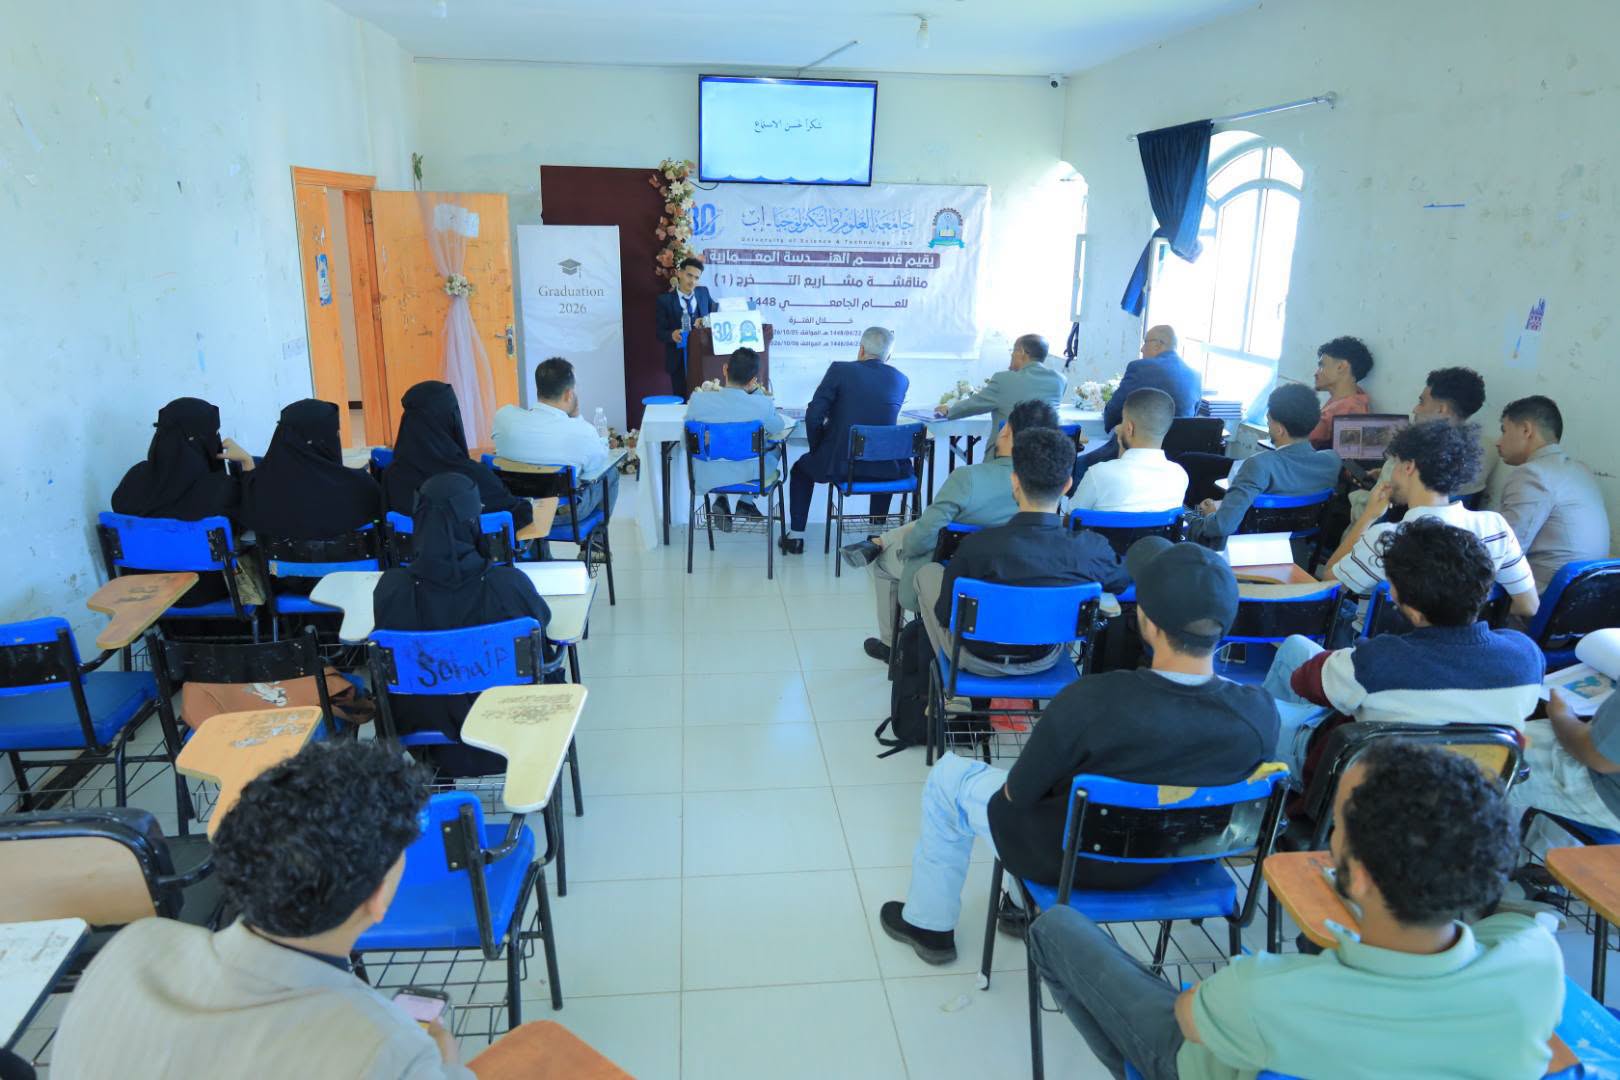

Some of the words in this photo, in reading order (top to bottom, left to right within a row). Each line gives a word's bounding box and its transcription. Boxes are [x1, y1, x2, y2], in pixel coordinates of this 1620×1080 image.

[741, 236, 784, 244] University
[708, 248, 780, 264] المعمارية
[783, 251, 850, 265] الهندسة
[905, 254, 935, 268] يقيم
[736, 273, 801, 288] التخرج
[803, 273, 864, 289] مشاريع
[865, 274, 929, 289] مناقشة
[538, 284, 605, 298] Graduation
[559, 302, 588, 315] 2026
[778, 297, 860, 312] الجامعي
[861, 297, 909, 311] للعام
